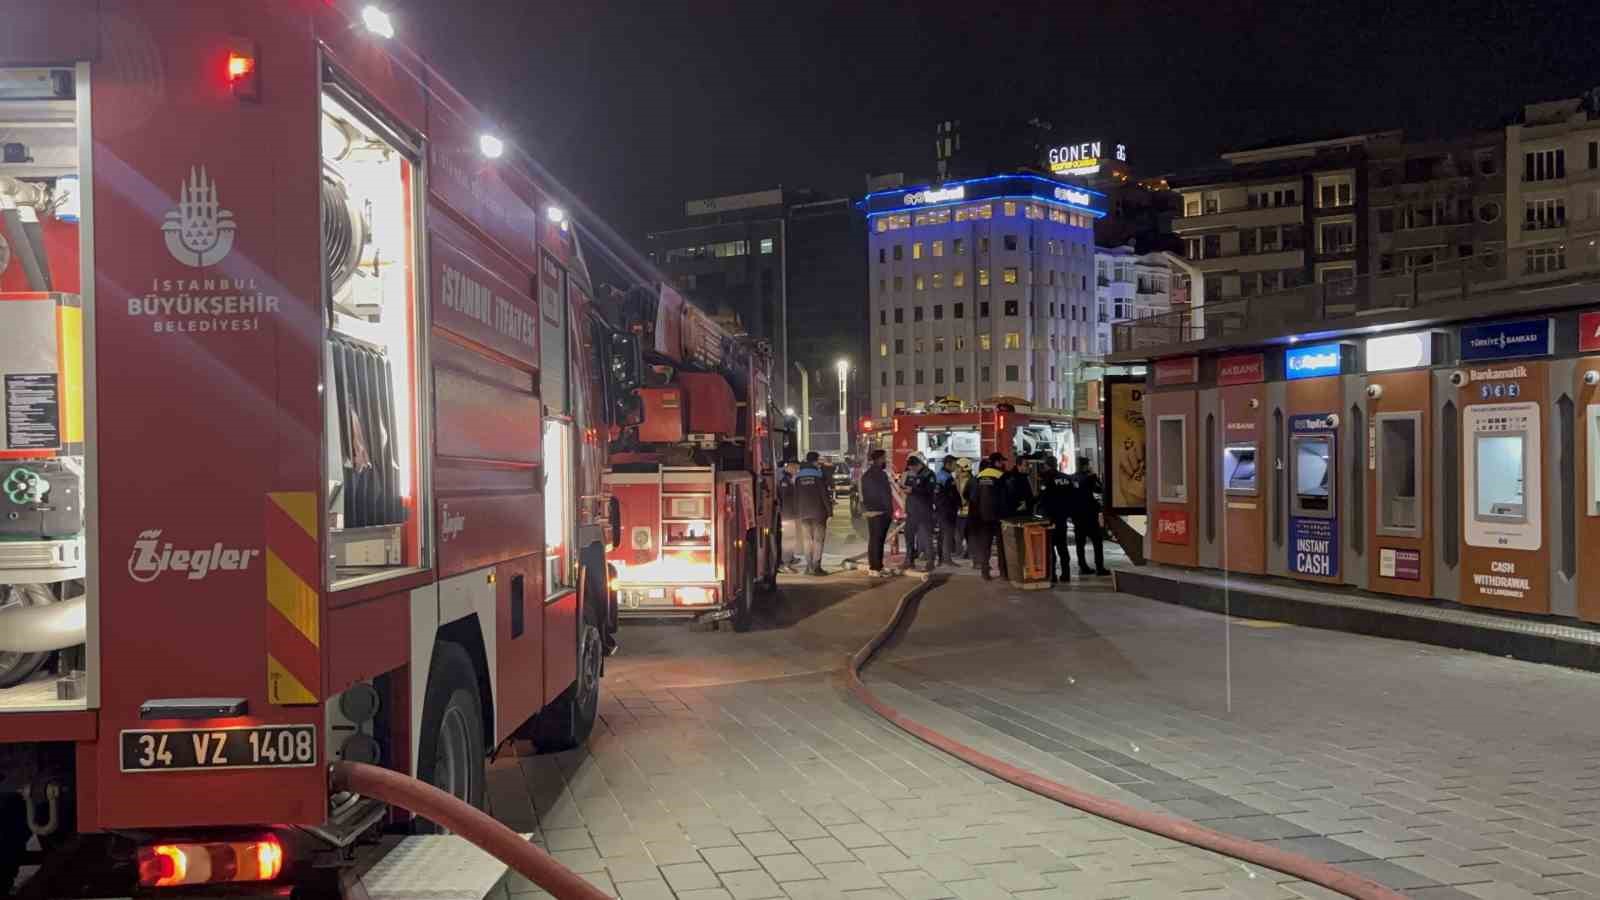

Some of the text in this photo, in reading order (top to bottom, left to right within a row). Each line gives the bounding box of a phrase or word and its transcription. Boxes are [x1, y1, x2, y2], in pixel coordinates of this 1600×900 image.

[152, 278, 257, 292] İSTANBUL
[127, 293, 280, 315] BÜYÜKŞEHİR
[153, 318, 259, 332] BELEDİYESİ
[1506, 333, 1537, 344] BANKASI
[1220, 362, 1259, 376] AKBANK
[1470, 365, 1528, 381] Bankamatik
[1297, 539, 1329, 554] INSTANT
[128, 529, 260, 582] Ziegler
[1297, 553, 1330, 575] CASH
[1491, 561, 1515, 574] CASH
[1473, 573, 1531, 590] WITHDRAWAL
[138, 730, 312, 766] 34 VZ 1408
